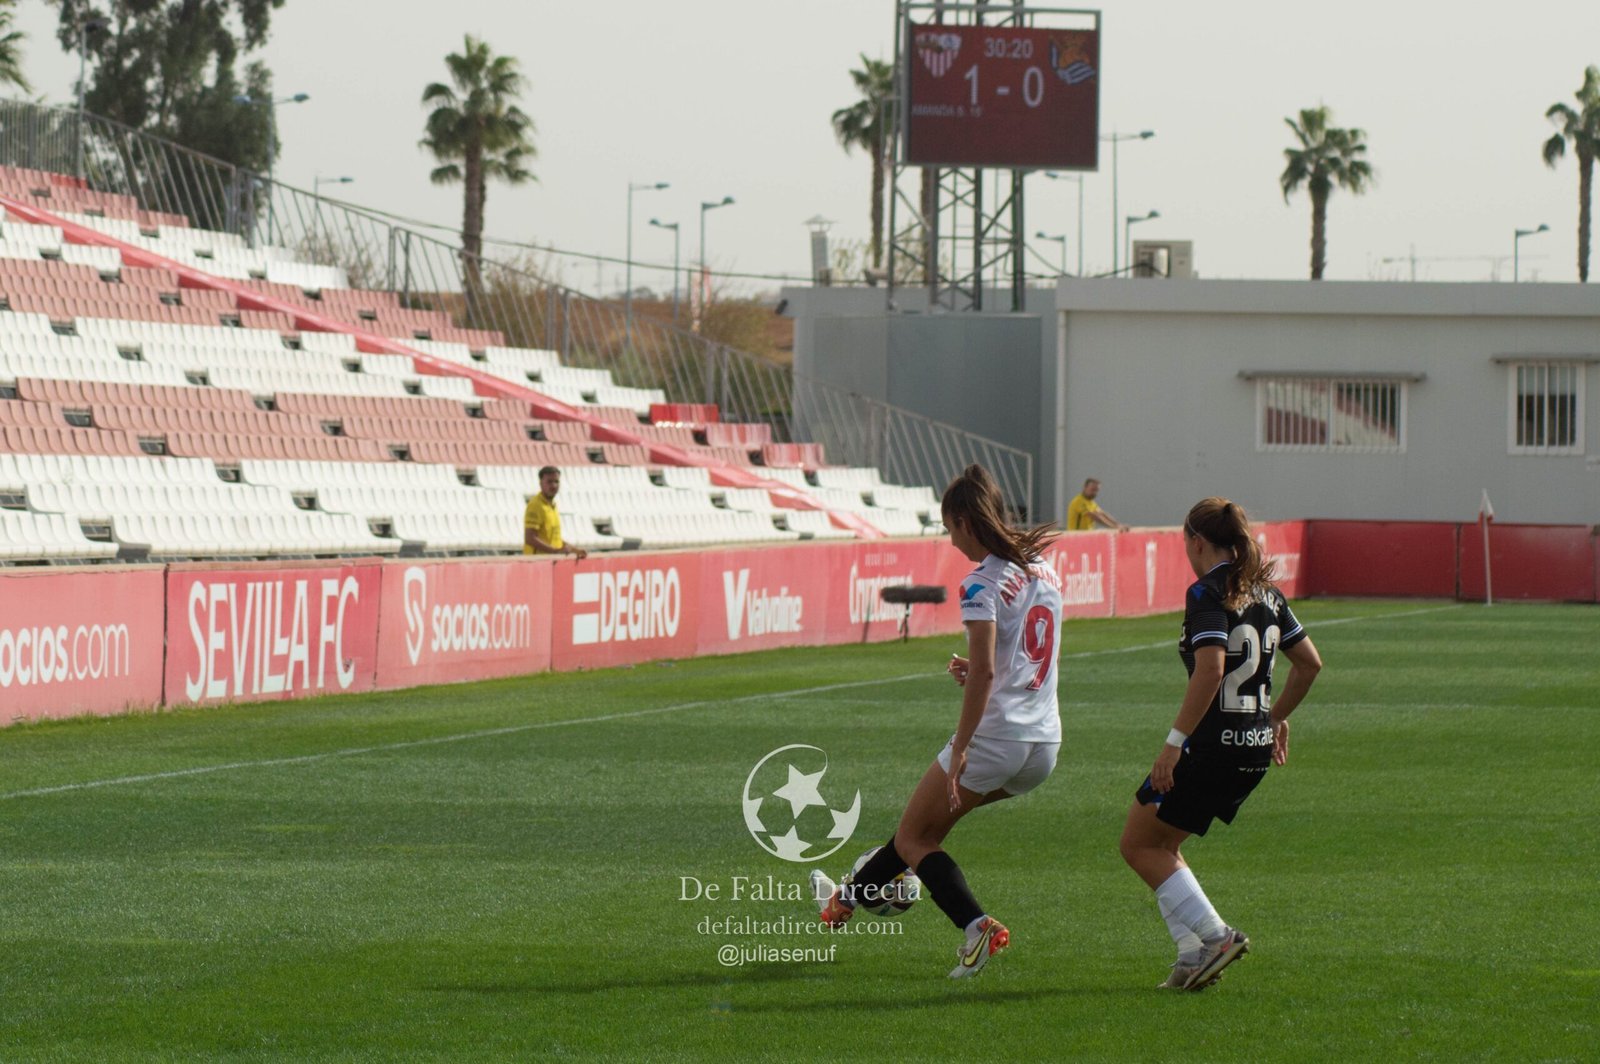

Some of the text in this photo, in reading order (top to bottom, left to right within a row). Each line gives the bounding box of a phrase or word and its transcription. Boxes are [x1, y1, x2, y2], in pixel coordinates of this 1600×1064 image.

[984, 38, 1034, 58] 30:20
[964, 64, 979, 105] 1
[1023, 66, 1044, 108] 0
[431, 603, 530, 652] socios.com
[600, 566, 680, 642] DEGIRO
[747, 586, 803, 637] Valvoline
[0, 623, 129, 687] ocios.com
[186, 576, 359, 703] SEVILLA FC
[1022, 604, 1055, 692] 9
